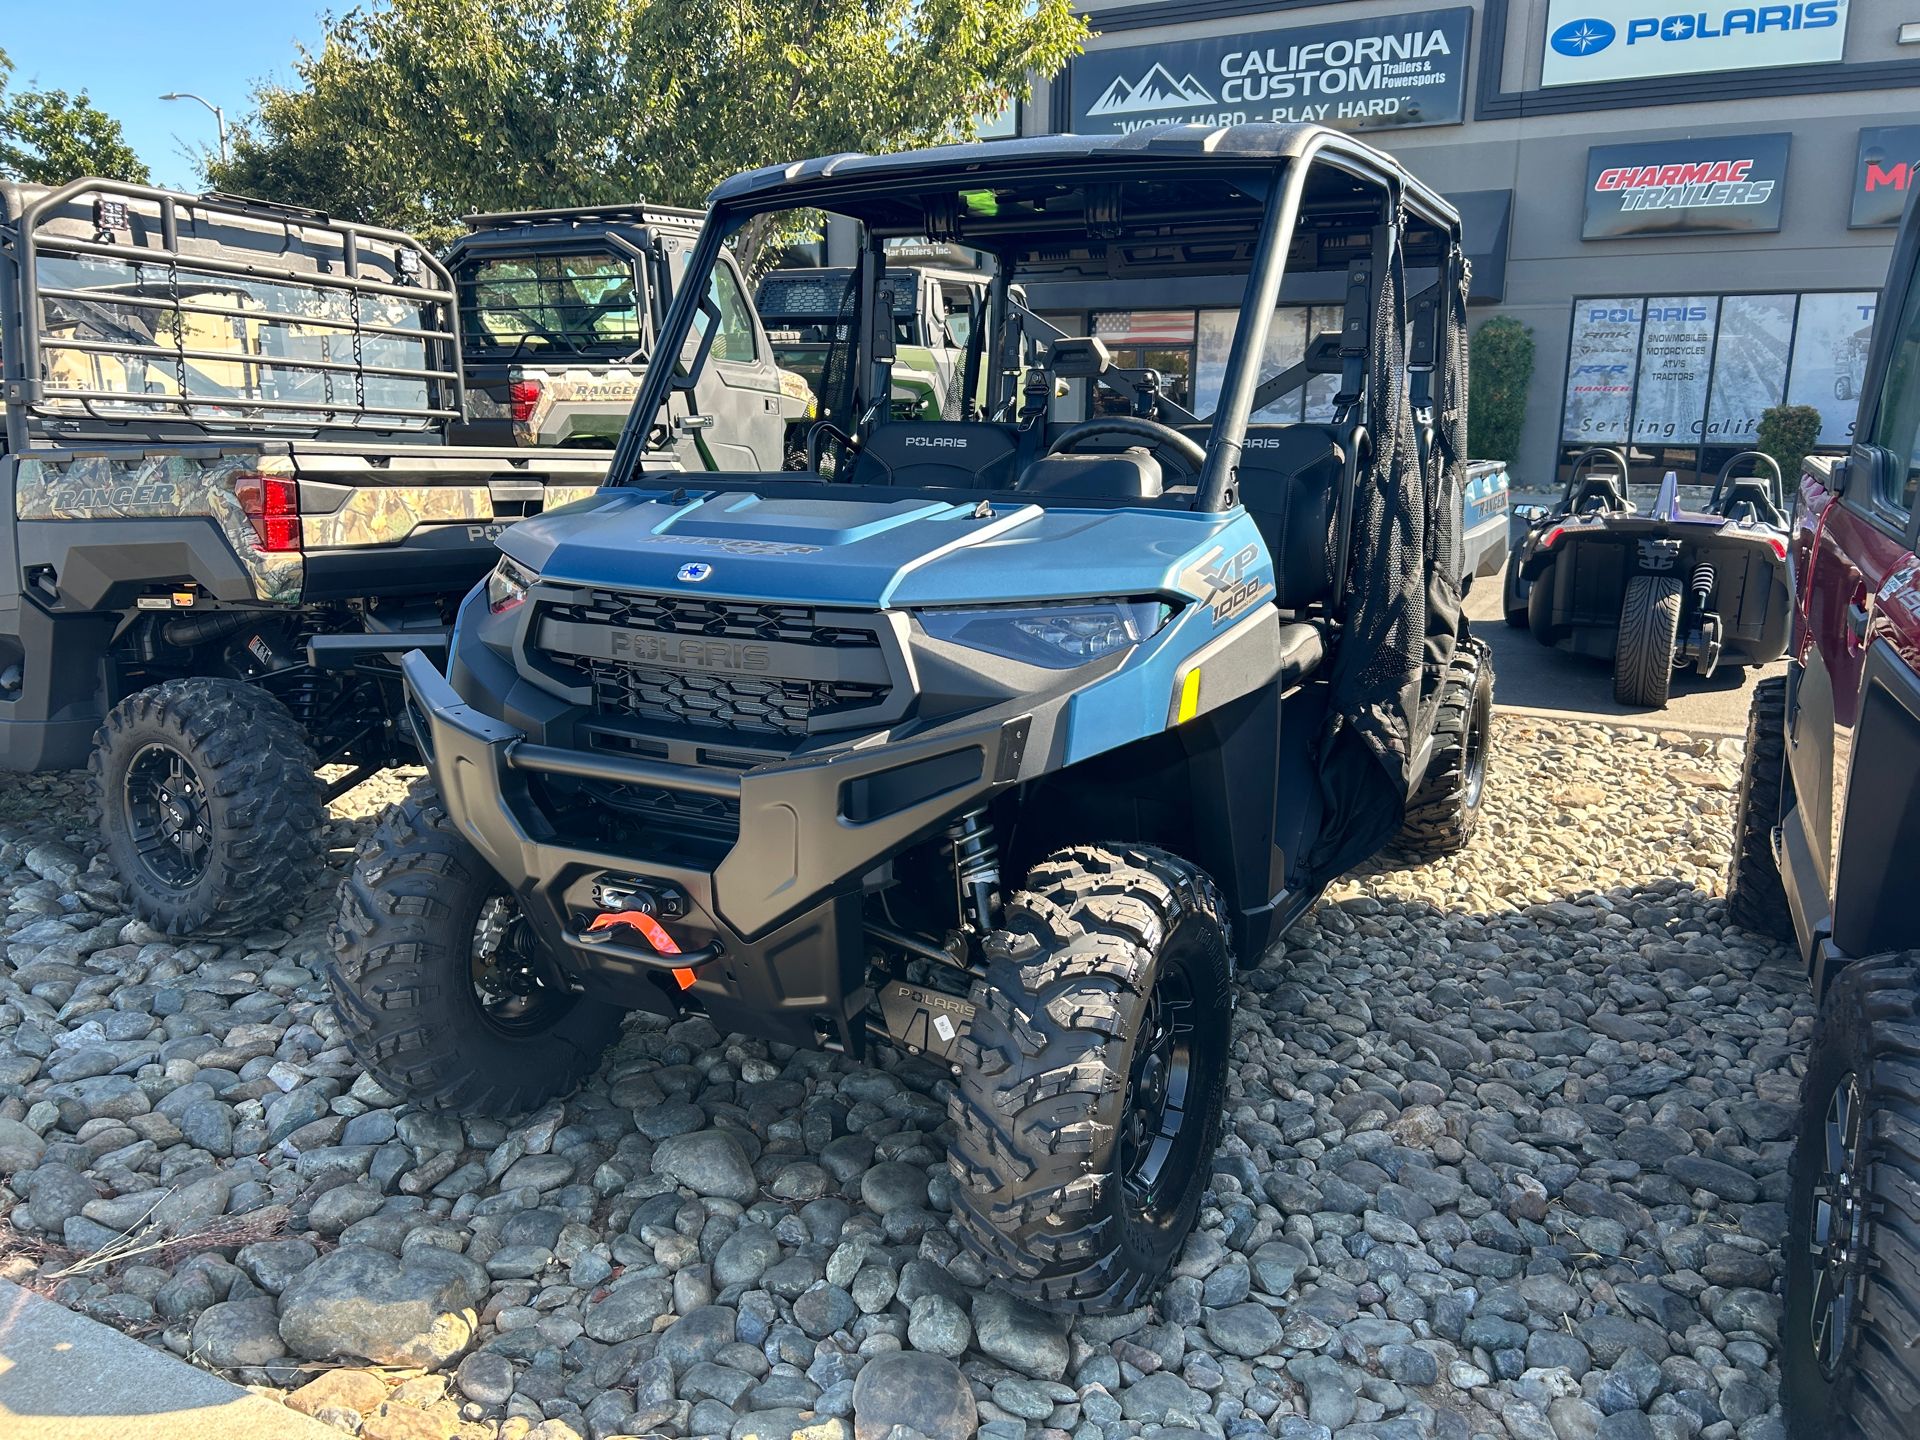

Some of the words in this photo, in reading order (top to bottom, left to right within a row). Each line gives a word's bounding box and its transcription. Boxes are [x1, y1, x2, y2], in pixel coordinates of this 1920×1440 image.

[1626, 0, 1838, 46] POLARIS
[1220, 29, 1450, 78] CALIFORNIA
[1383, 61, 1422, 75] Trailers
[1423, 60, 1432, 71] &
[1221, 64, 1382, 103] CUSTOM
[1381, 72, 1446, 89] Powersports
[1272, 104, 1330, 123] PLAY
[1595, 159, 1754, 191] CHARMAC
[1620, 180, 1775, 211] TRAILERS
[900, 247, 934, 256] Trailers,
[936, 246, 952, 255] Inc.
[1589, 306, 1707, 322] POLARIS
[1648, 333, 1708, 343] SNOWMOBILES
[1646, 346, 1706, 355] MOTORCYCLES
[1573, 364, 1629, 378] RZR
[1663, 359, 1686, 368] ATV'S
[1652, 372, 1695, 381] TRACTORS
[1581, 418, 1676, 438] Serving
[905, 436, 968, 448] POLARIS
[54, 484, 176, 510] RANGER
[1212, 576, 1259, 622] 1000
[611, 631, 769, 671] POLARIS
[898, 987, 976, 1018] POLARIS
